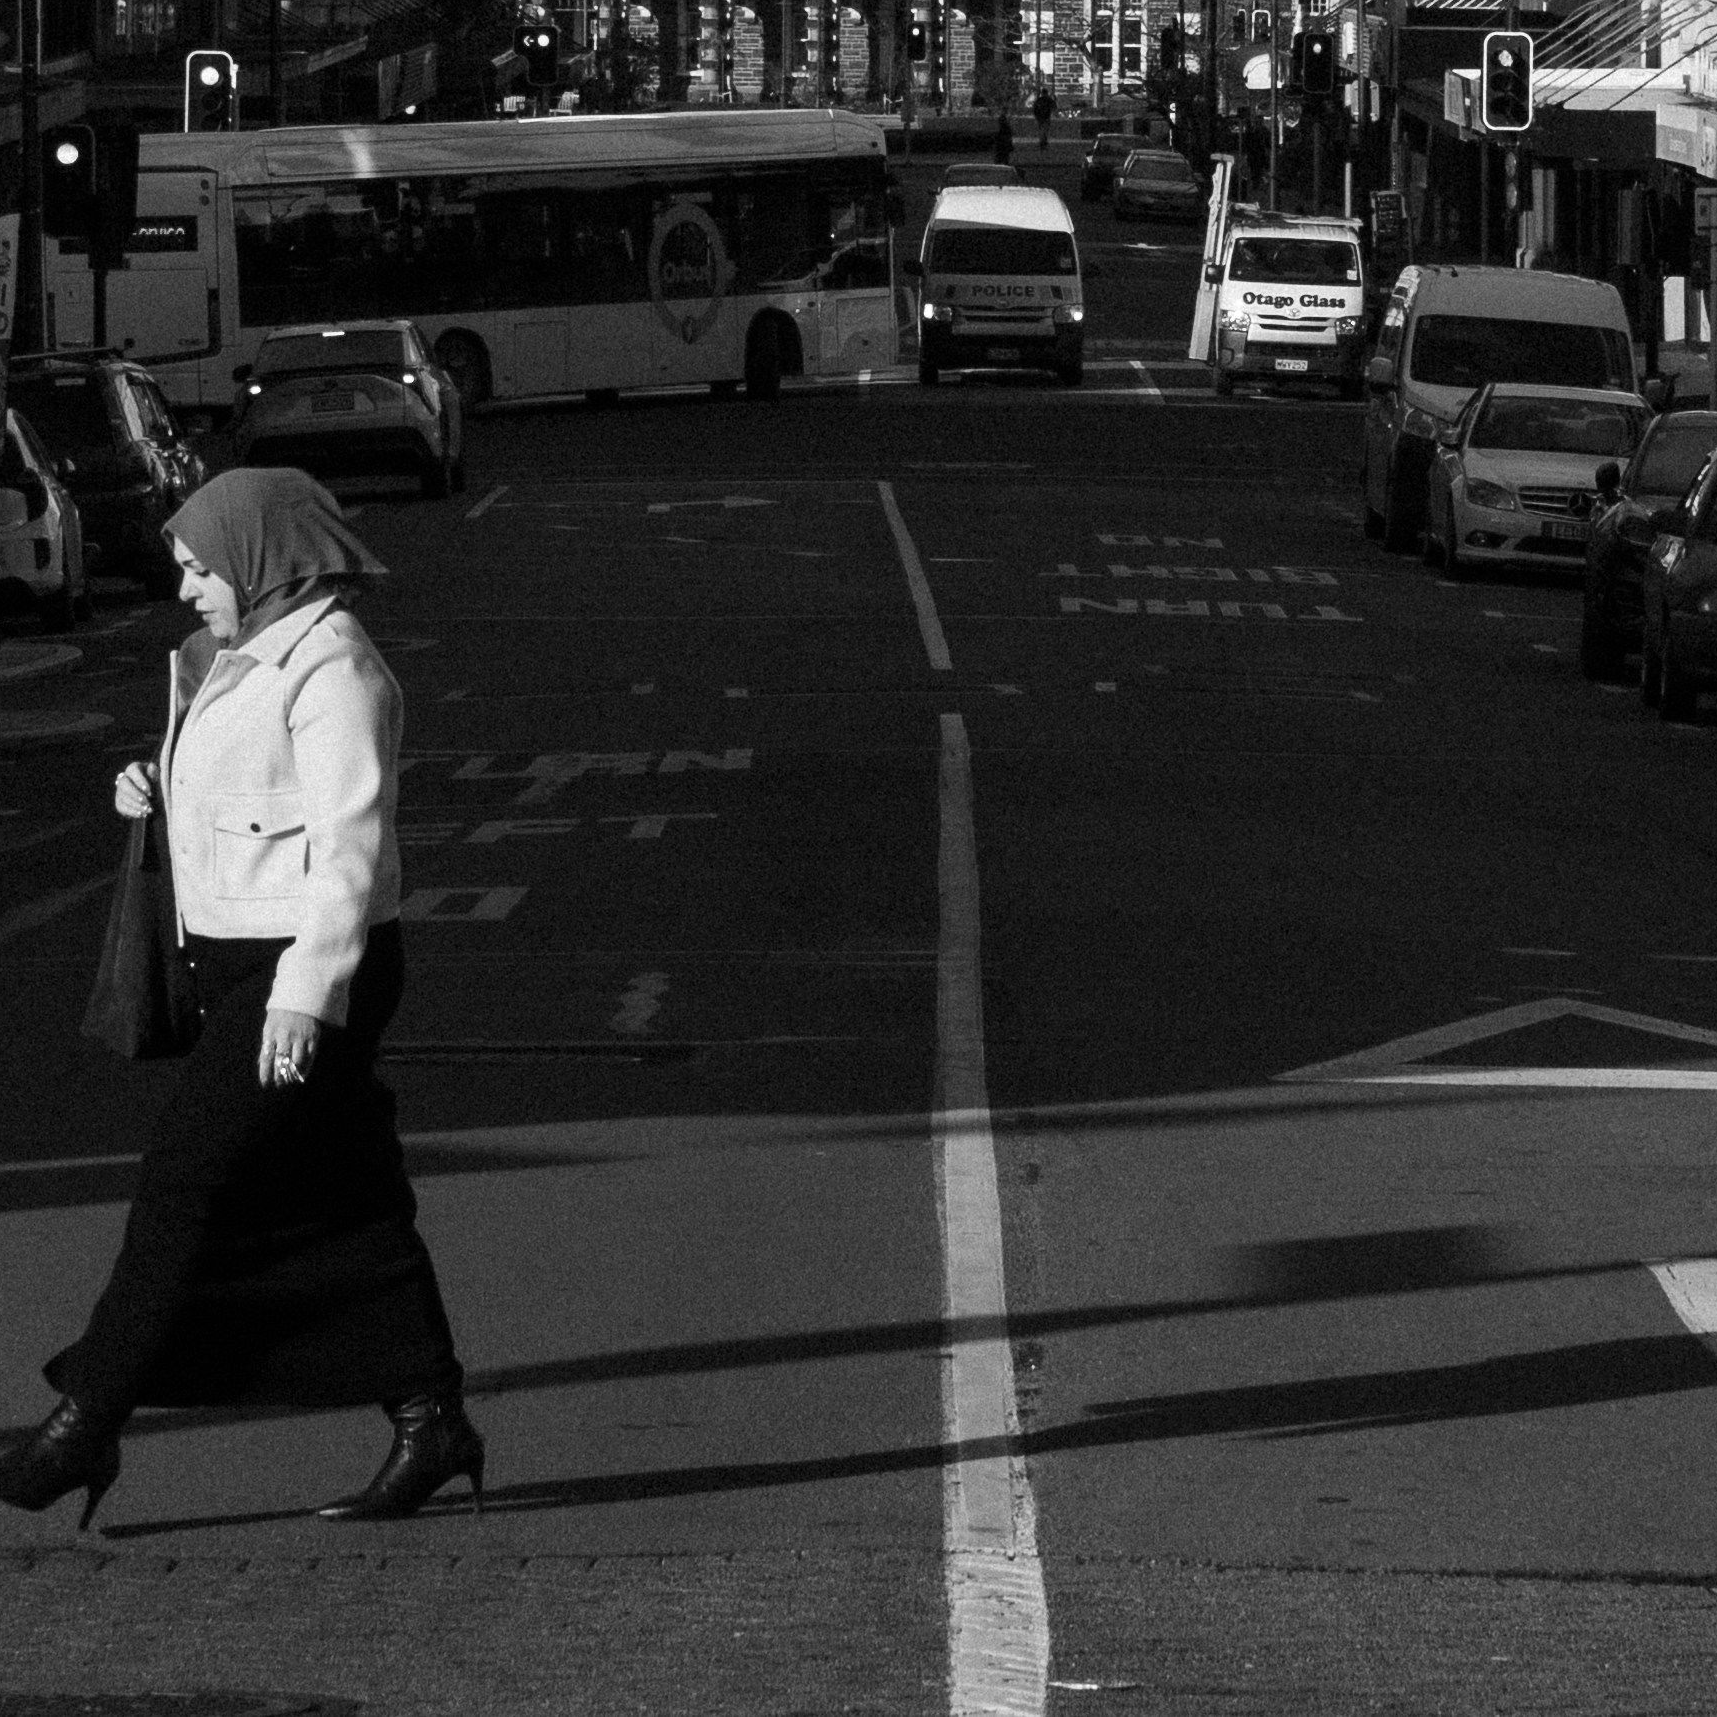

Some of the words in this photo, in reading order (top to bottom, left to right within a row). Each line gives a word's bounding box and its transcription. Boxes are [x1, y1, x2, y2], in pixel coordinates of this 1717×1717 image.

[972, 284, 1035, 298] POLICE
[1242, 292, 1295, 310] Otago
[1299, 294, 1346, 309] Glass
[1037, 562, 1341, 586] RIGHT
[1058, 596, 1366, 622] TURN
